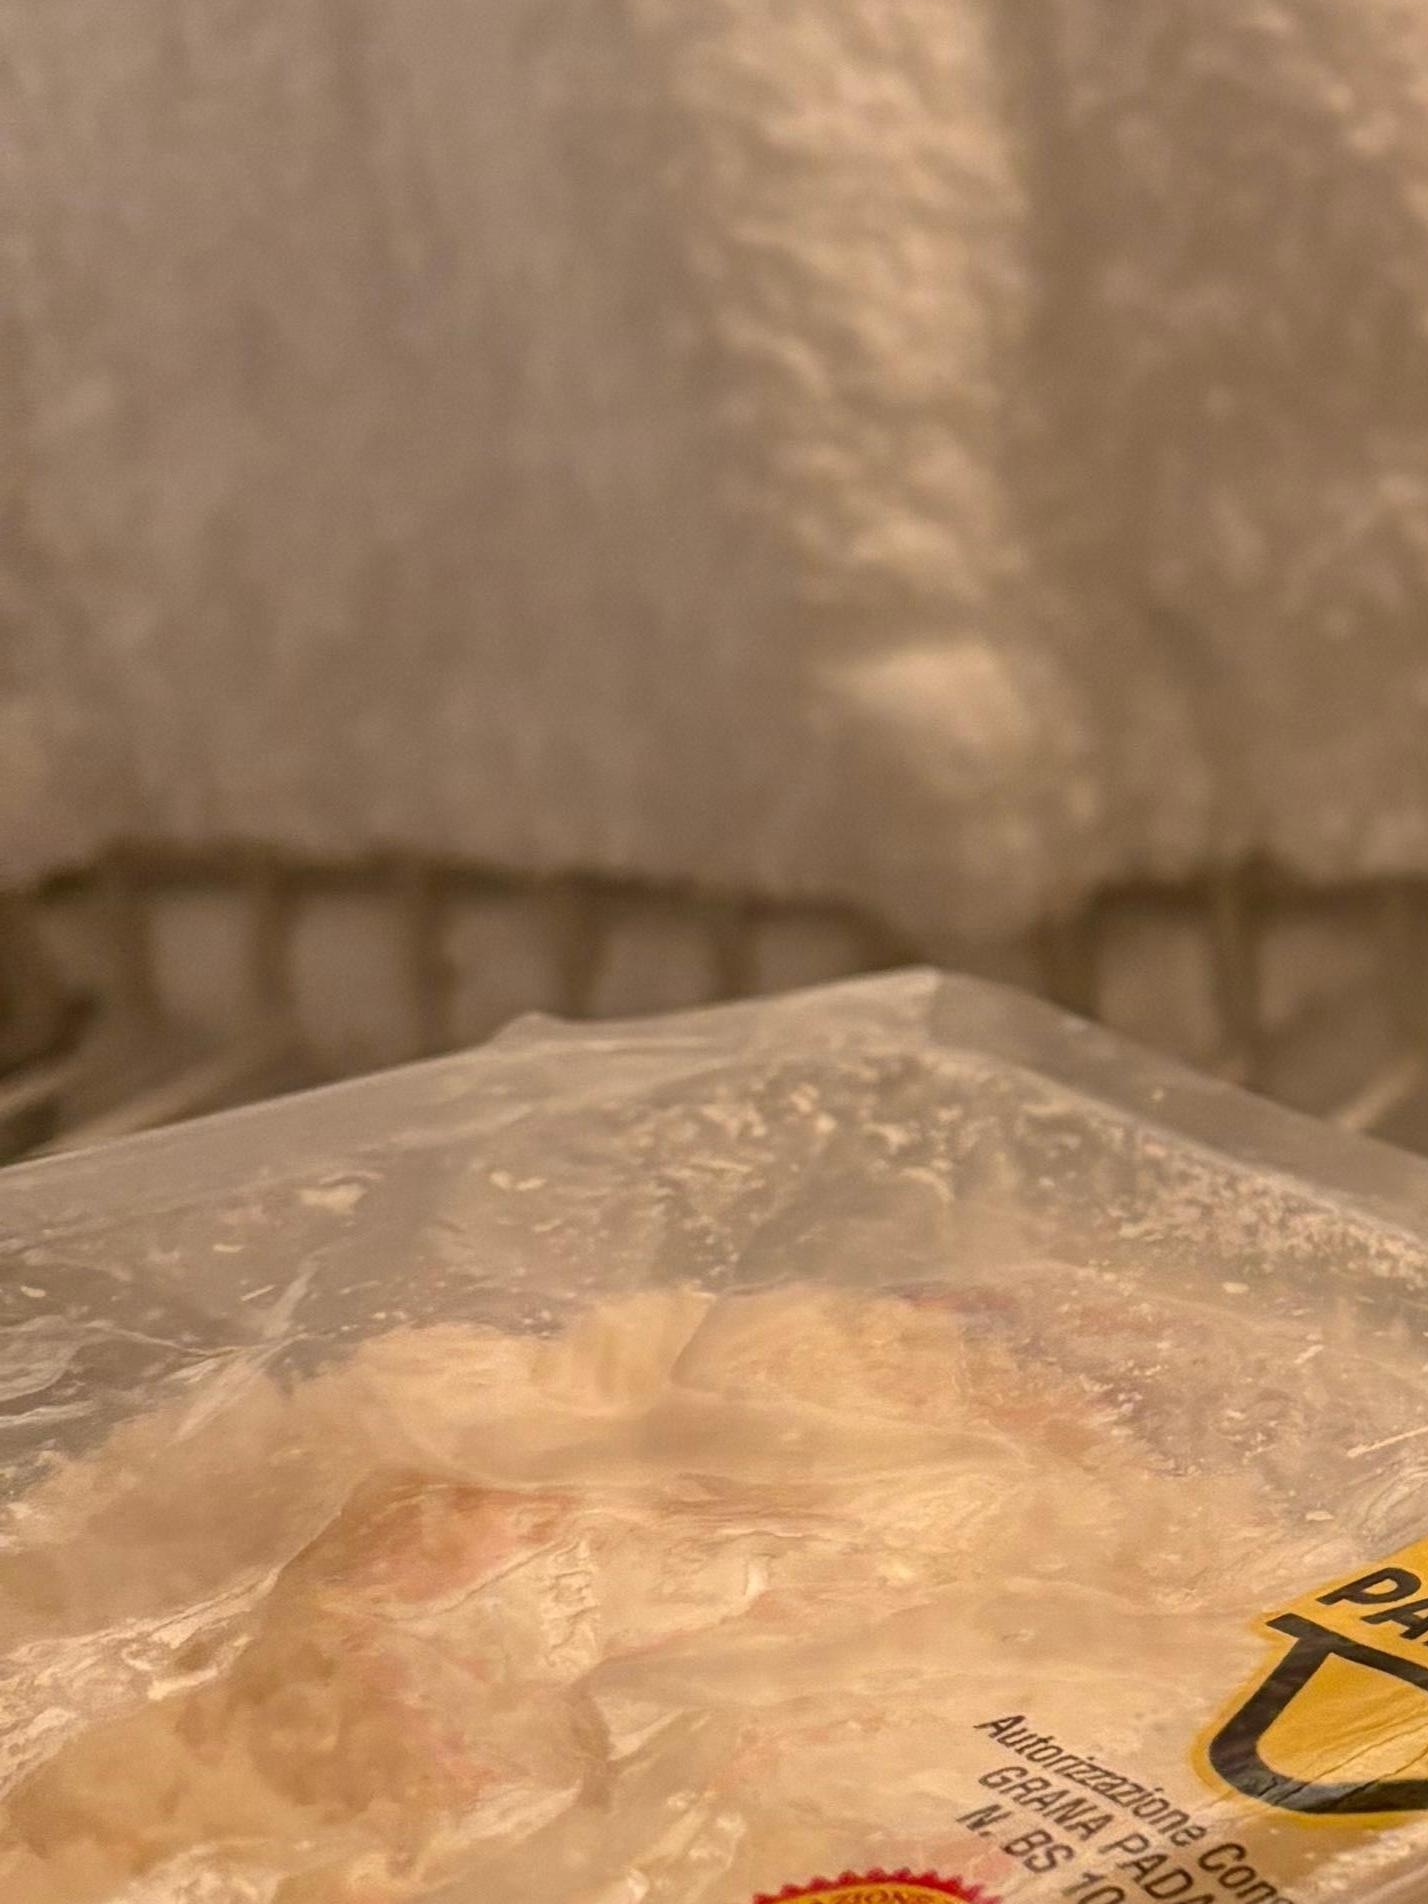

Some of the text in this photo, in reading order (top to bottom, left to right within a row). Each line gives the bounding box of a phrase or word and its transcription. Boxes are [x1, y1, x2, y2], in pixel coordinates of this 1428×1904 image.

[974, 1714, 1207, 1847] Autorizzazione
[978, 1765, 1113, 1842] GRANA
[956, 1803, 995, 1837] N.
[1004, 1829, 1075, 1874] BS
